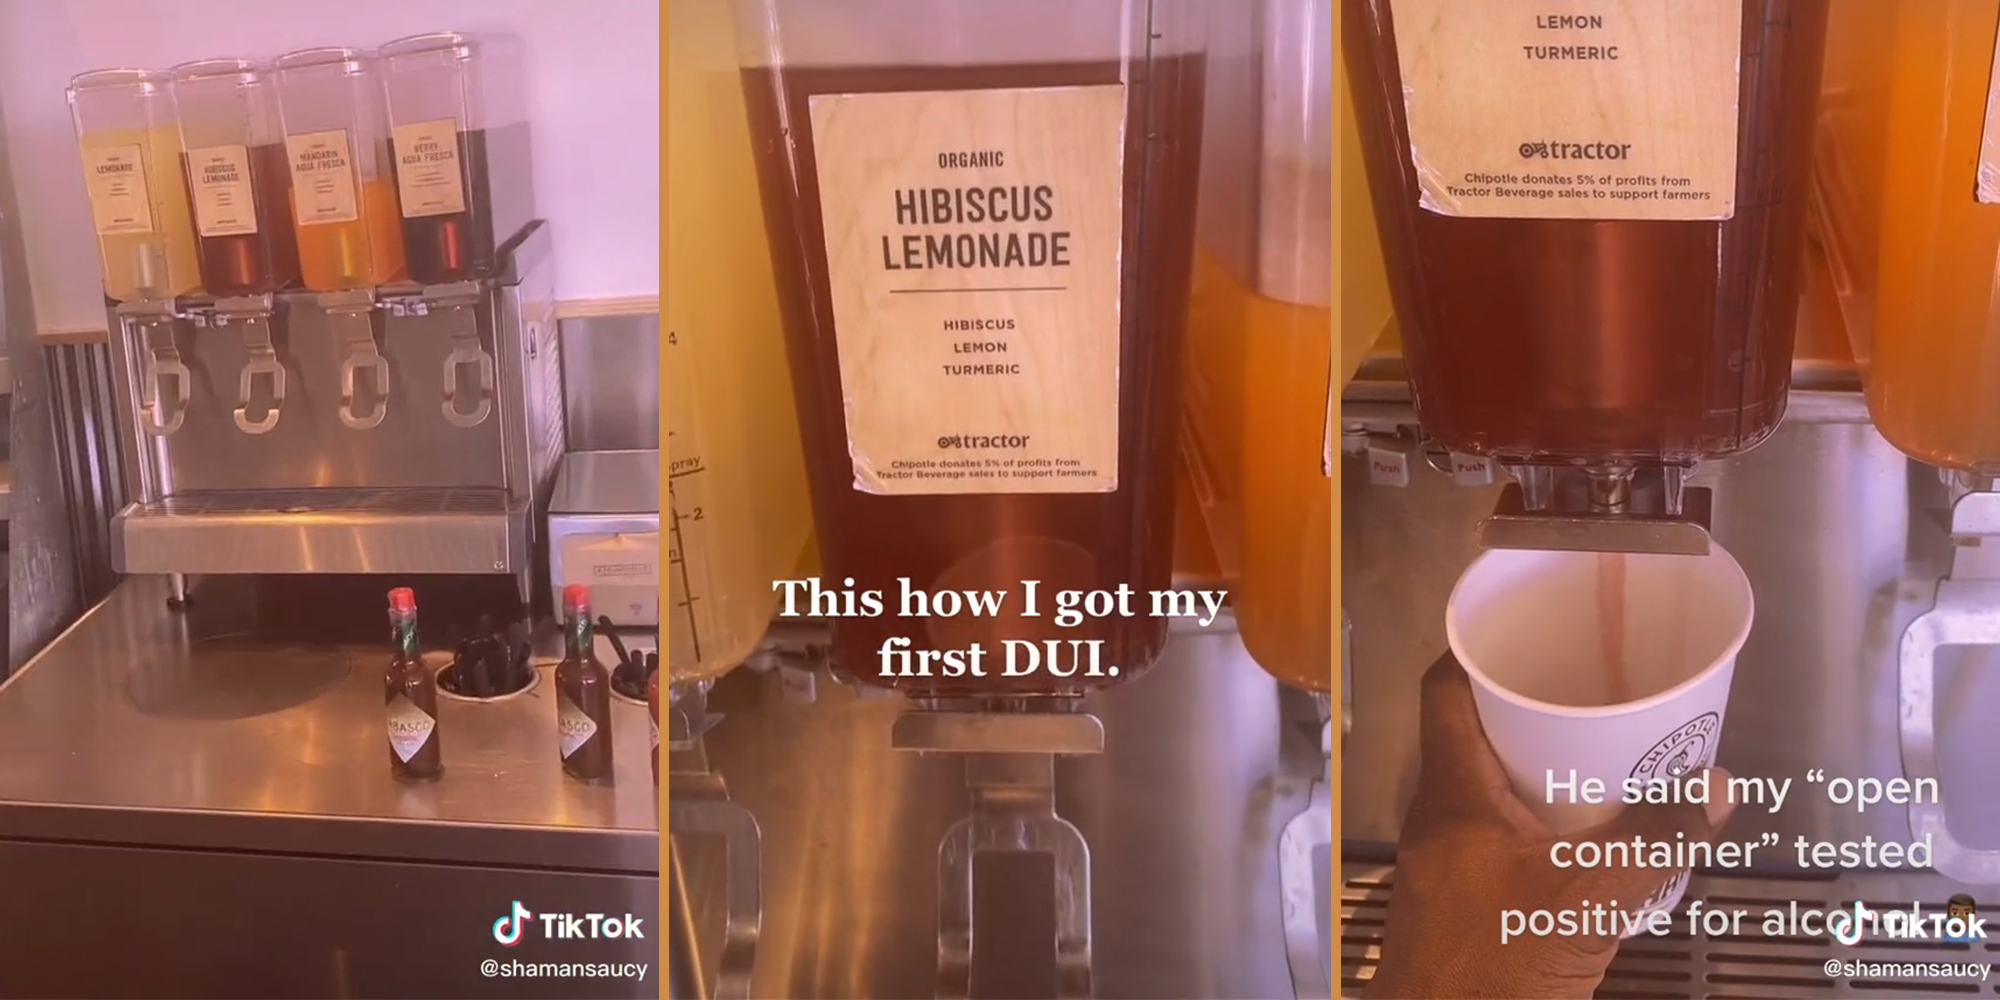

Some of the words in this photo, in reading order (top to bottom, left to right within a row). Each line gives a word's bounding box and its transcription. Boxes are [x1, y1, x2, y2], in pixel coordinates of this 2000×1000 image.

[1536, 14, 1603, 30] LEMON
[1523, 45, 1619, 61] TURMERIC
[1550, 140, 1632, 160] tractor
[938, 151, 1005, 169] ORGANIC
[1464, 173, 1518, 185] Chipotle
[1522, 174, 1573, 185] donates
[1576, 175, 1596, 185] 5%
[1599, 175, 1611, 185] of
[1616, 175, 1657, 187] profits
[1661, 175, 1691, 186] from
[1446, 186, 1491, 197] Tractor
[1495, 187, 1554, 199] Beverage
[1558, 188, 1589, 198] sales
[1593, 189, 1606, 199] to
[1610, 189, 1658, 200] support
[1662, 189, 1711, 200] farmers
[895, 185, 1053, 225] HIBISCUS
[882, 231, 1071, 270] LEMONADE
[943, 319, 1016, 331] HIBISCUS
[953, 342, 1008, 353] LEMON
[943, 364, 1020, 376] TURMERIC
[963, 434, 1031, 449] tractor
[891, 460, 936, 469] Chipotle
[939, 460, 982, 469] donates
[984, 459, 1000, 468] 5%
[1003, 459, 1014, 468] of
[1017, 459, 1052, 468] profits
[1055, 458, 1081, 467] from
[1373, 461, 1401, 474] Push
[1458, 462, 1486, 473] Push
[876, 470, 914, 480] Tractor
[916, 470, 966, 479] Beverage
[969, 470, 994, 478] sales
[998, 470, 1009, 478] to
[1012, 470, 1053, 478] support
[1056, 469, 1097, 478] farmers
[693, 507, 705, 520] 2
